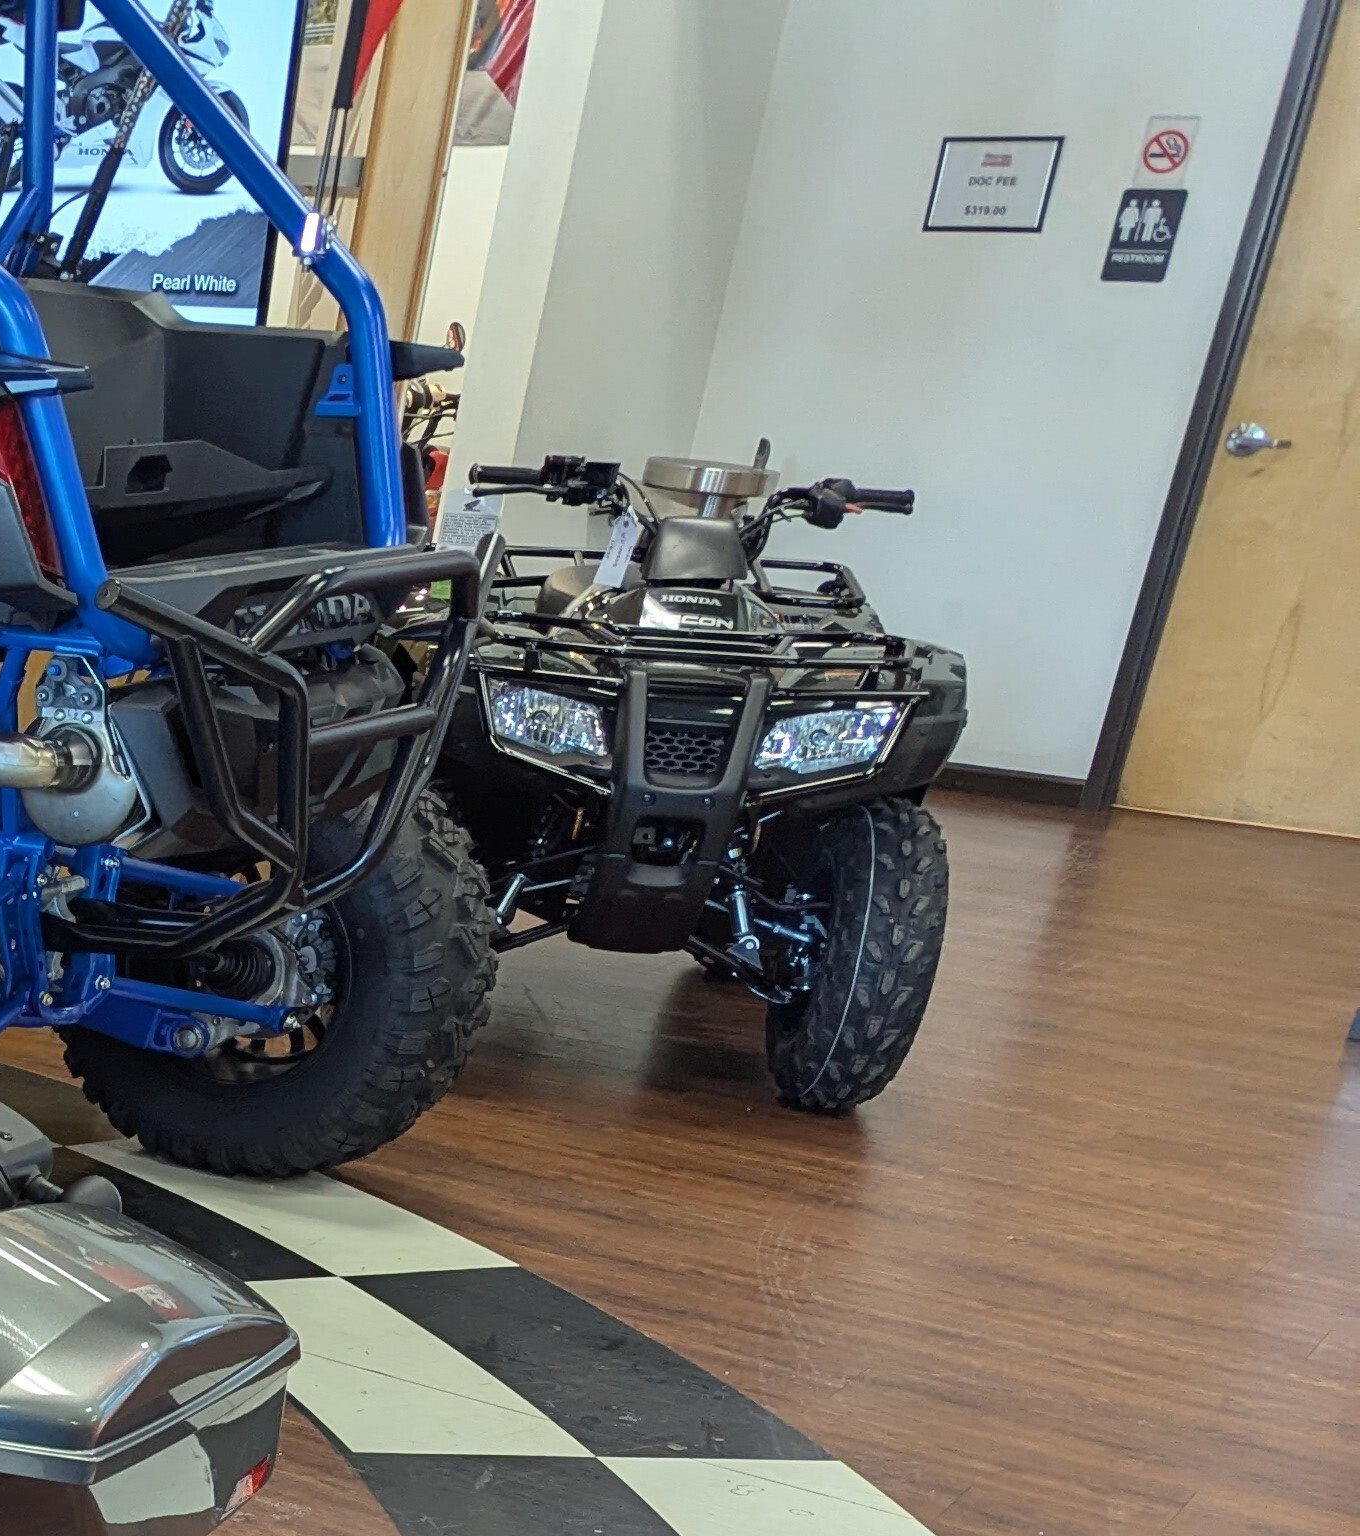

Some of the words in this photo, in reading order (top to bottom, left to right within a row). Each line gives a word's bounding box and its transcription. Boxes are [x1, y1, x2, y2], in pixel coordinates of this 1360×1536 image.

[967, 175, 993, 187] DOC
[995, 175, 1018, 187] FEE
[151, 273, 190, 291] Pearl
[194, 274, 237, 292] White
[660, 594, 723, 608] HONDA
